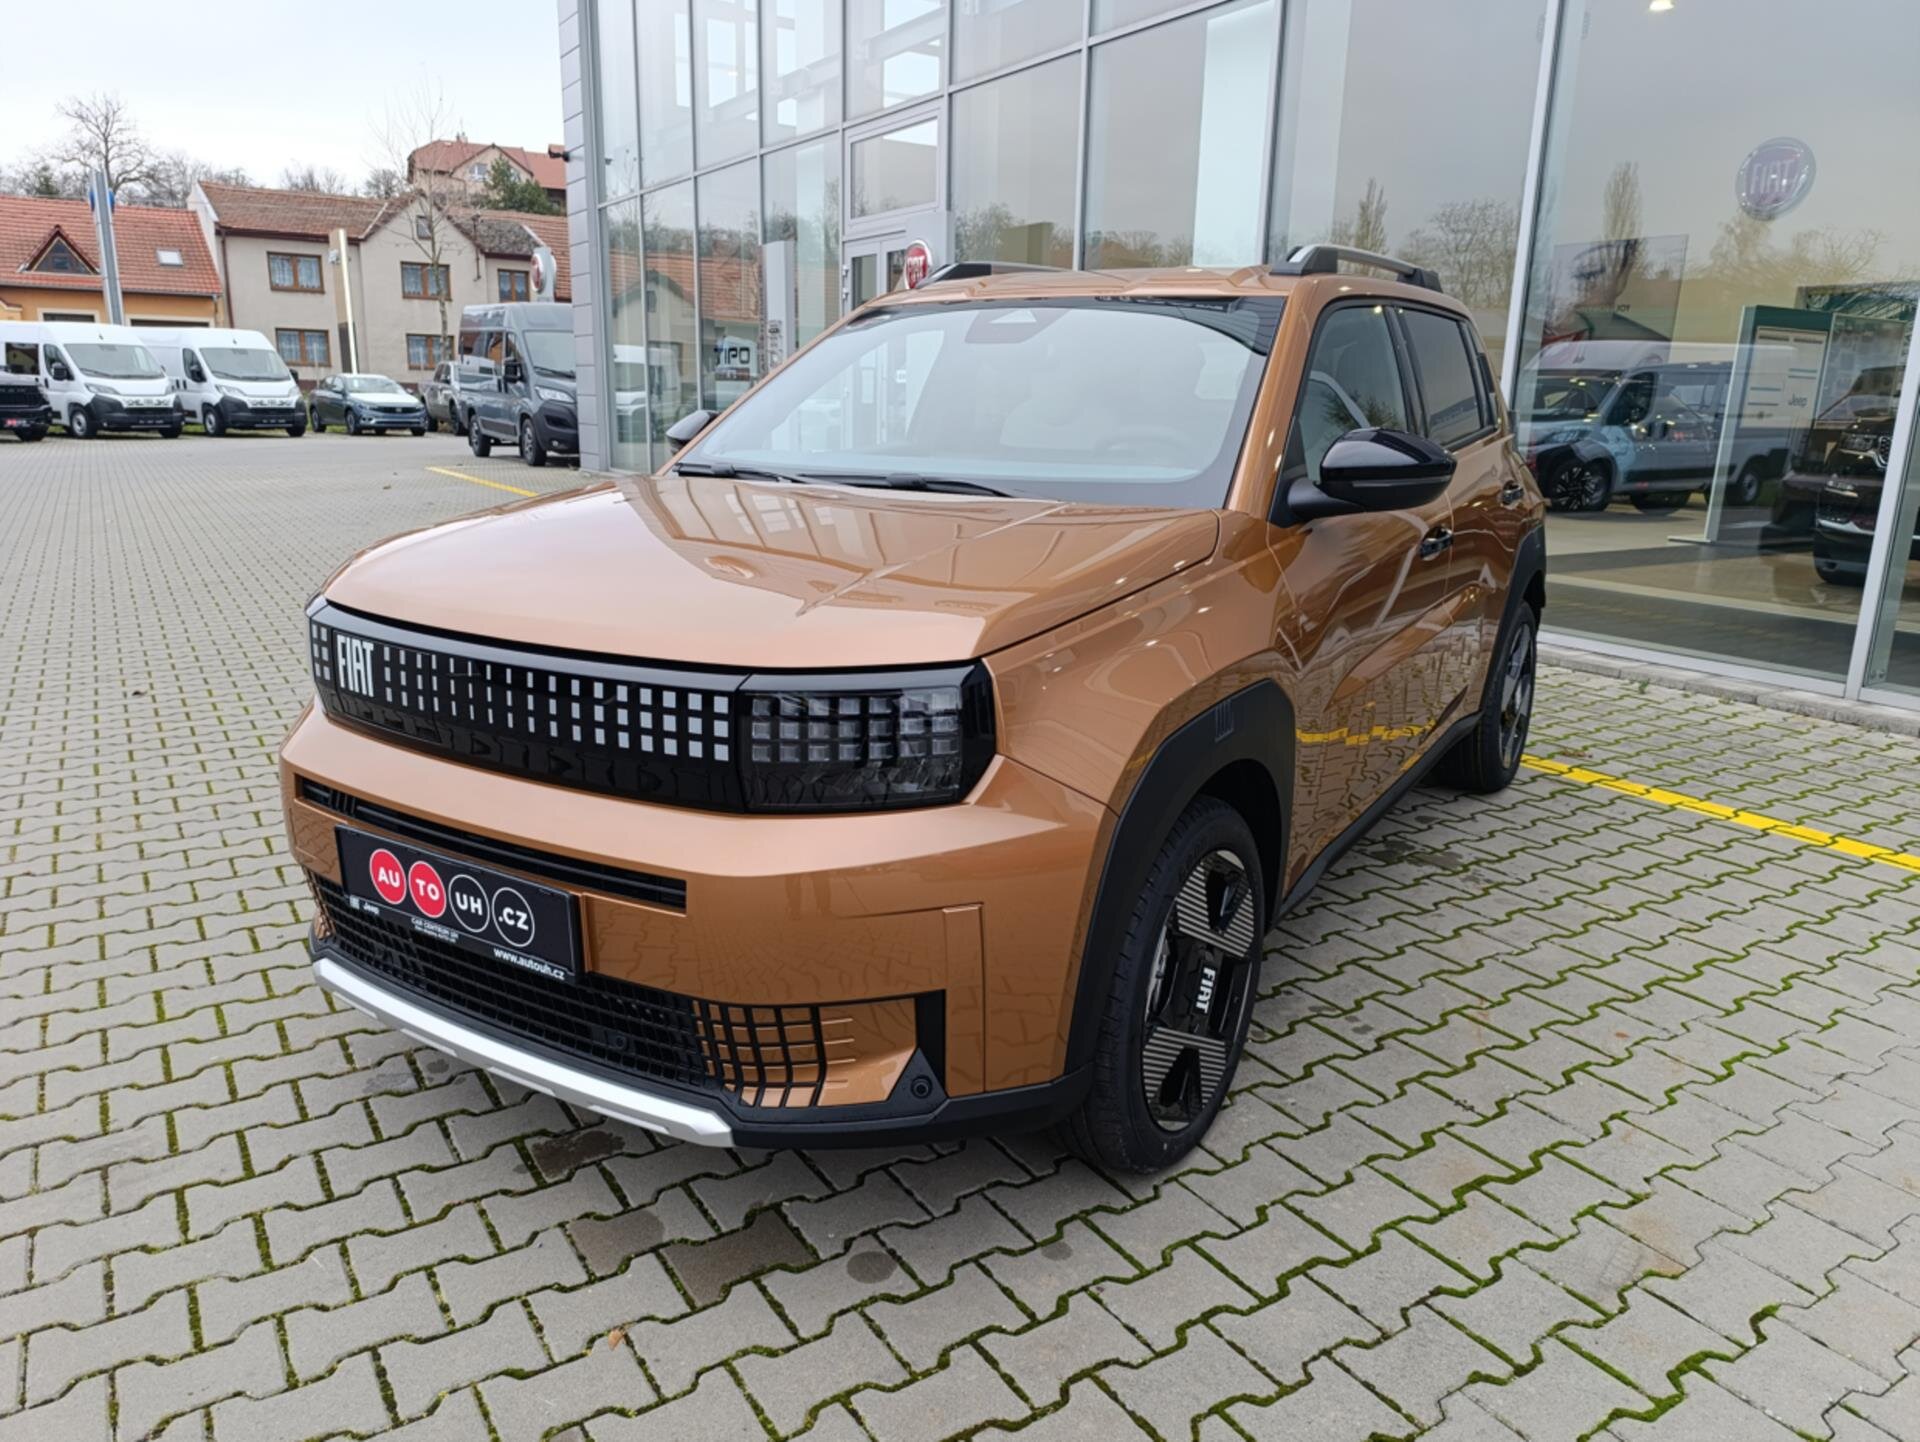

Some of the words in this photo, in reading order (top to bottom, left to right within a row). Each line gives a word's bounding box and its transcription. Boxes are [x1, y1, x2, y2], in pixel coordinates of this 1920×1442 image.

[1750, 158, 1797, 194] FIAT
[337, 634, 374, 697] FIAT
[378, 866, 400, 888] AU
[415, 878, 440, 901] TO
[455, 892, 482, 916] UH
[493, 948, 565, 980] www.autouh.cz
[1196, 967, 1216, 1014] FIAT
